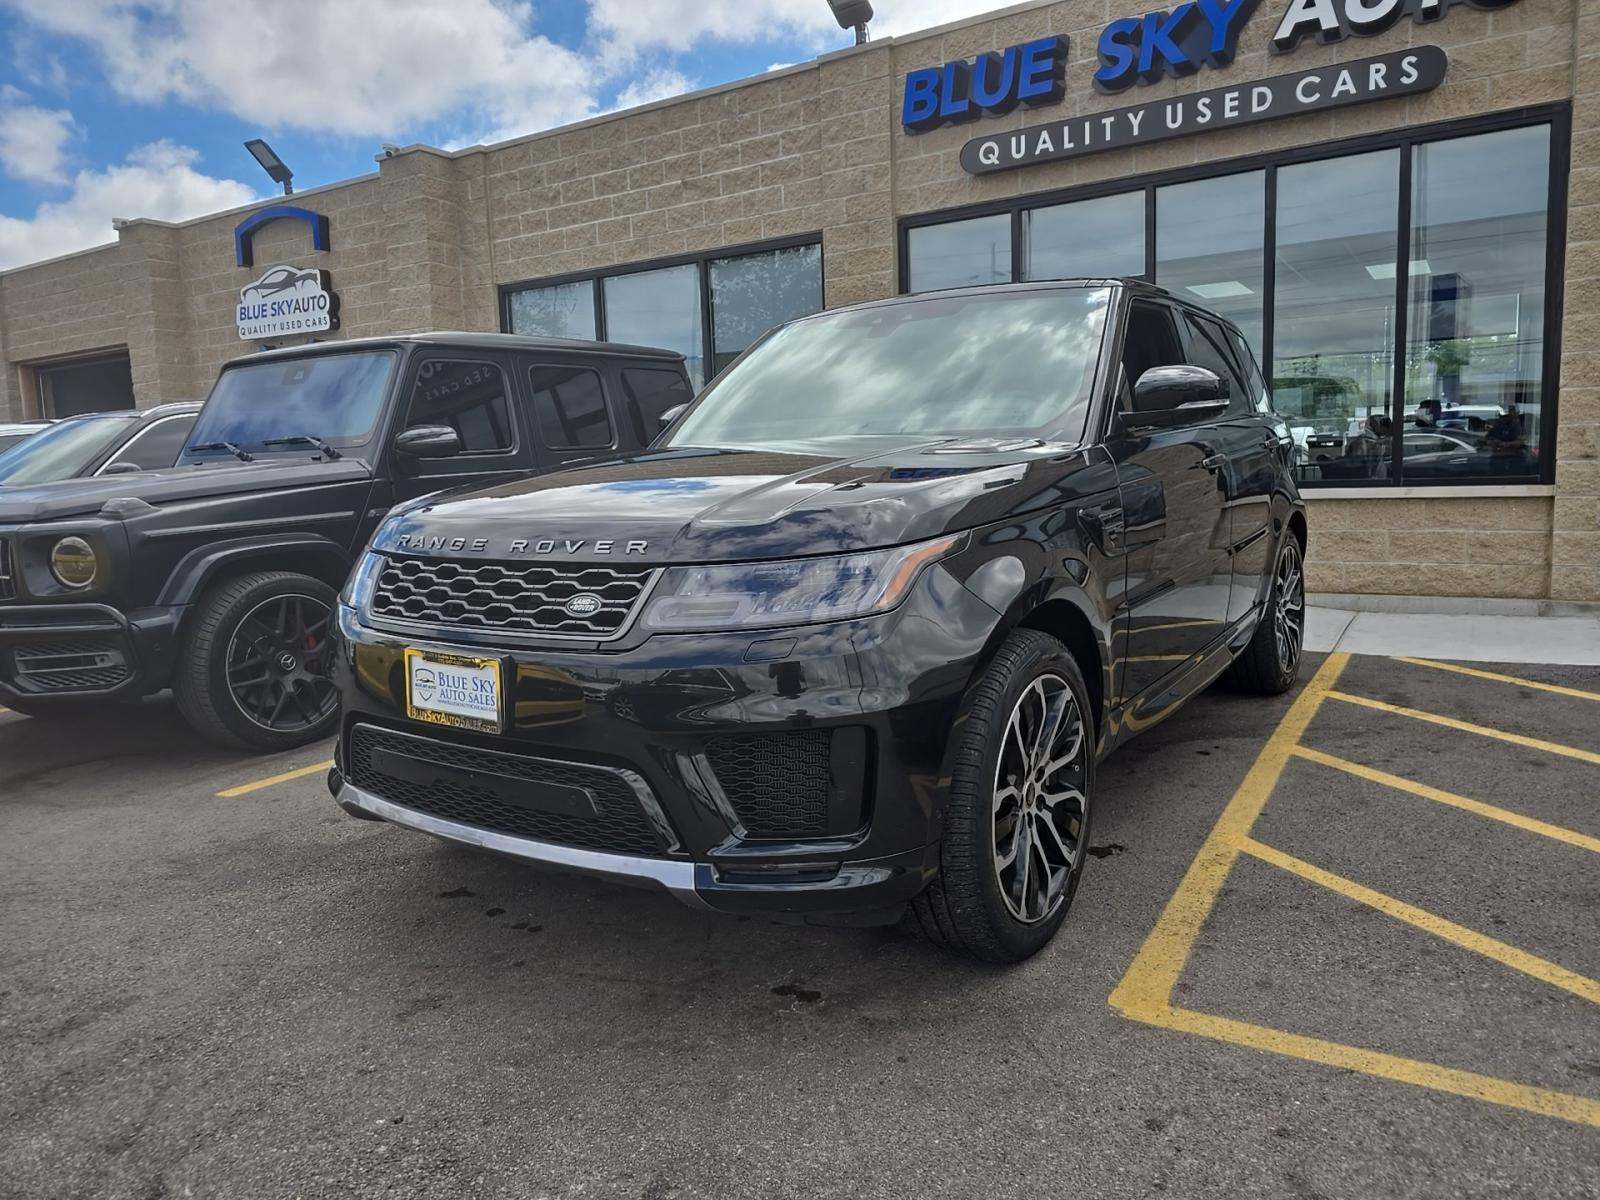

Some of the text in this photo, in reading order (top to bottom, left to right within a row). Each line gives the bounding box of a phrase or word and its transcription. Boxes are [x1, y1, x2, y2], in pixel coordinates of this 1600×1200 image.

[902, 37, 1061, 127] BLUE
[1093, 0, 1244, 82] SKY
[978, 54, 1420, 166] QUALITY USED CARS
[240, 303, 268, 321] BLUE
[240, 316, 328, 336] QUALITY USED CARS
[397, 534, 649, 555] RANGE ROVER
[438, 671, 468, 690] BLUE
[472, 676, 496, 694] SKY
[440, 690, 466, 702] AUTO
[468, 692, 496, 707] SALES
